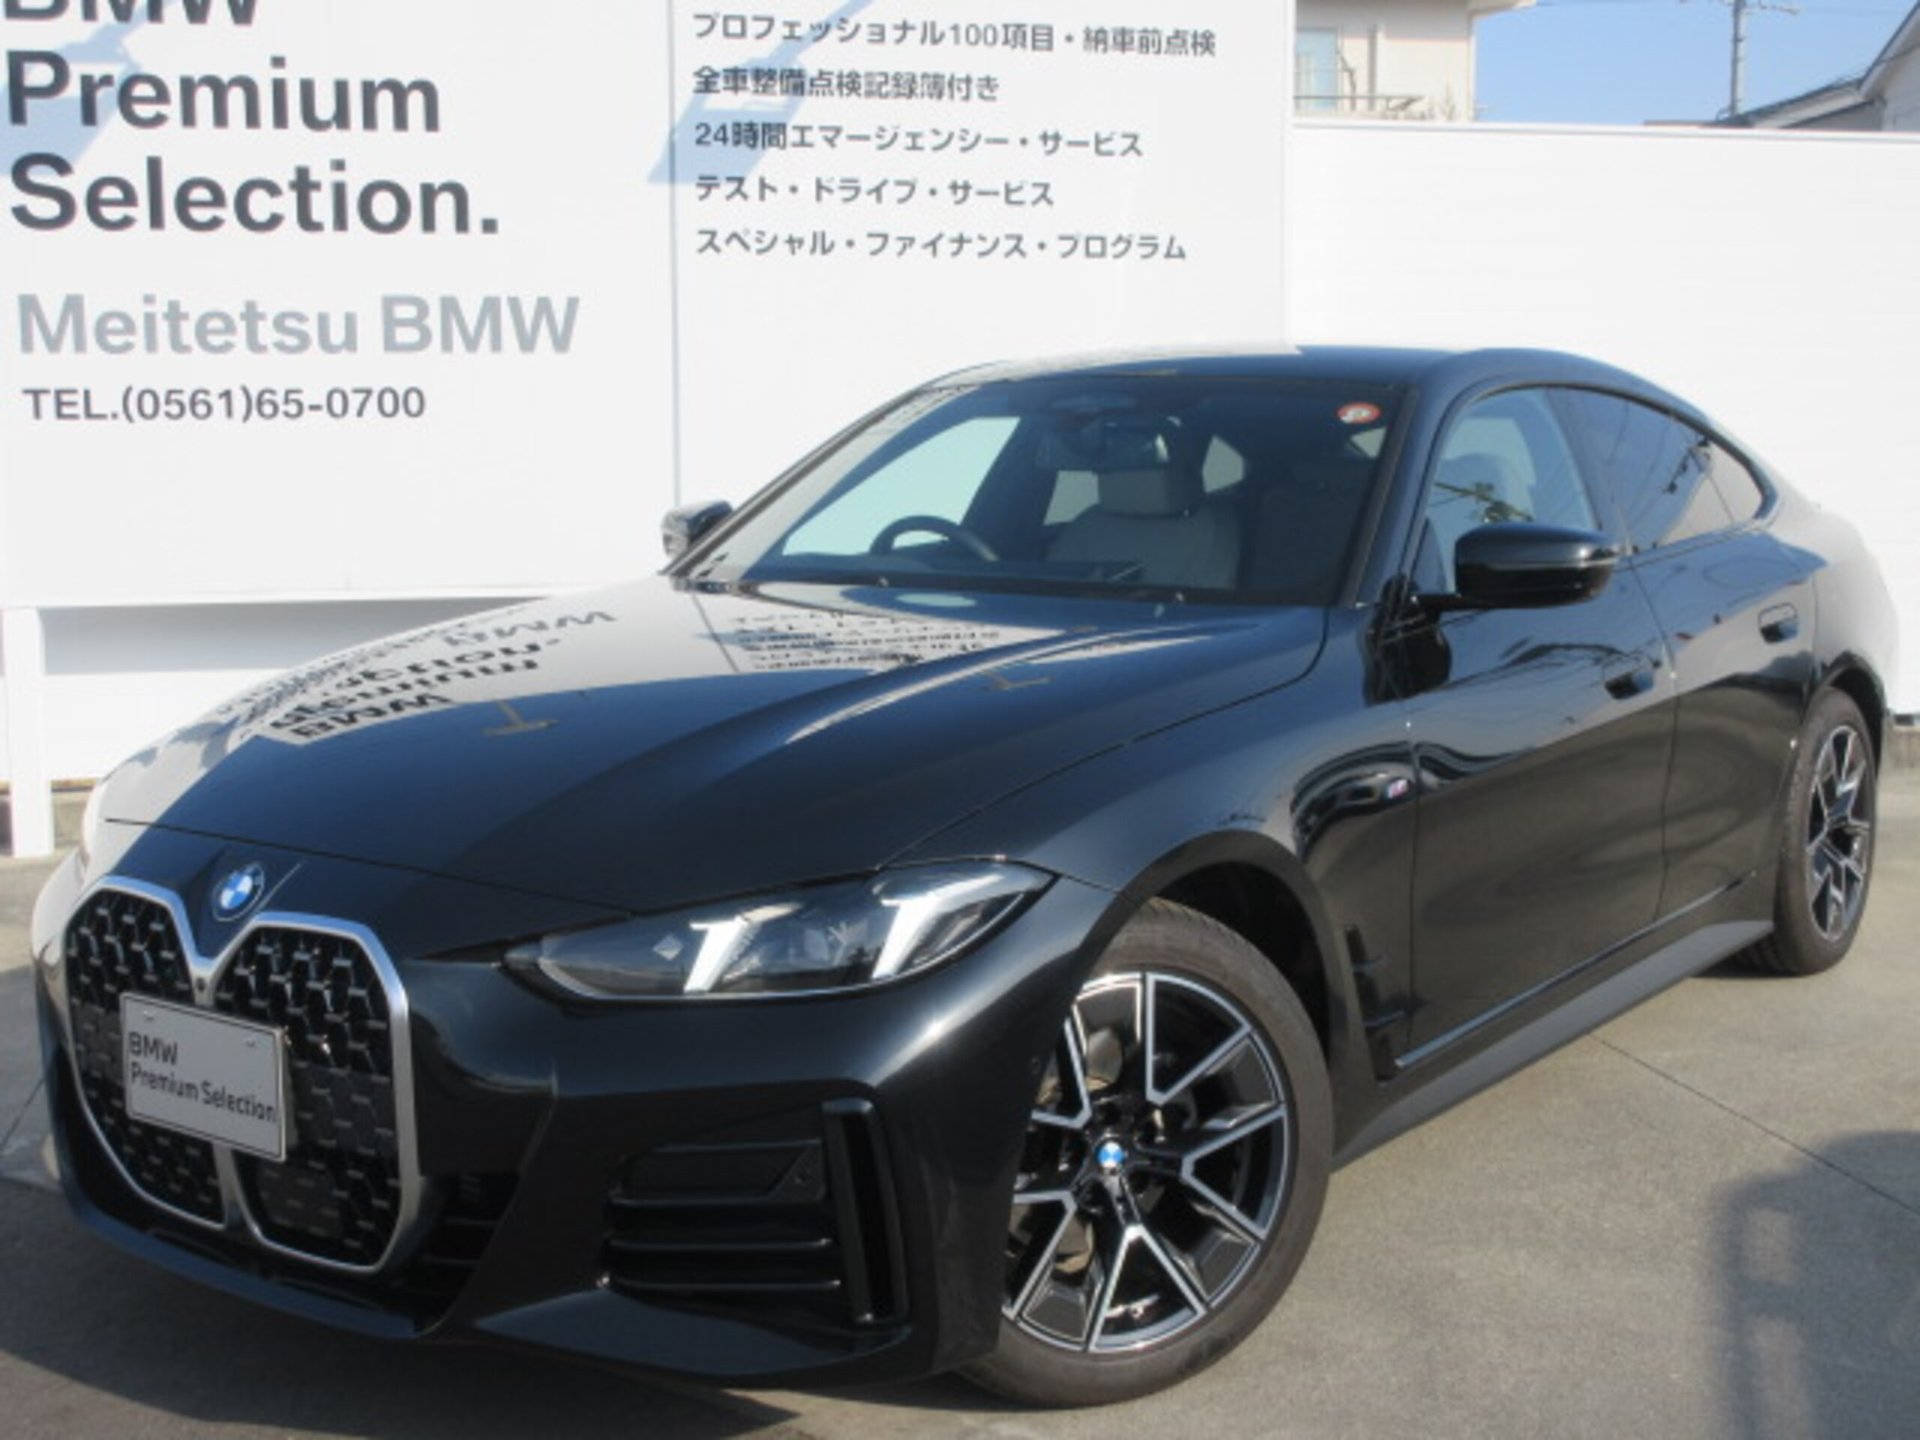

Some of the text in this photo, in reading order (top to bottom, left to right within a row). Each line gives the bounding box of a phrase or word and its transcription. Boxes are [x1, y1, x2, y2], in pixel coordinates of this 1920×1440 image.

[7, 49, 438, 133] Premium
[10, 151, 500, 235] Selection.
[695, 174, 1055, 207] テスト・ドライブ・サービス
[696, 229, 1187, 261] スペシャル・ファイナンス・プログラム
[17, 293, 580, 355] Meitetsu BMW
[22, 385, 426, 423] TEL.(0561)65-0700
[128, 1032, 178, 1066] BMW
[131, 1061, 277, 1124] Premium Selection
